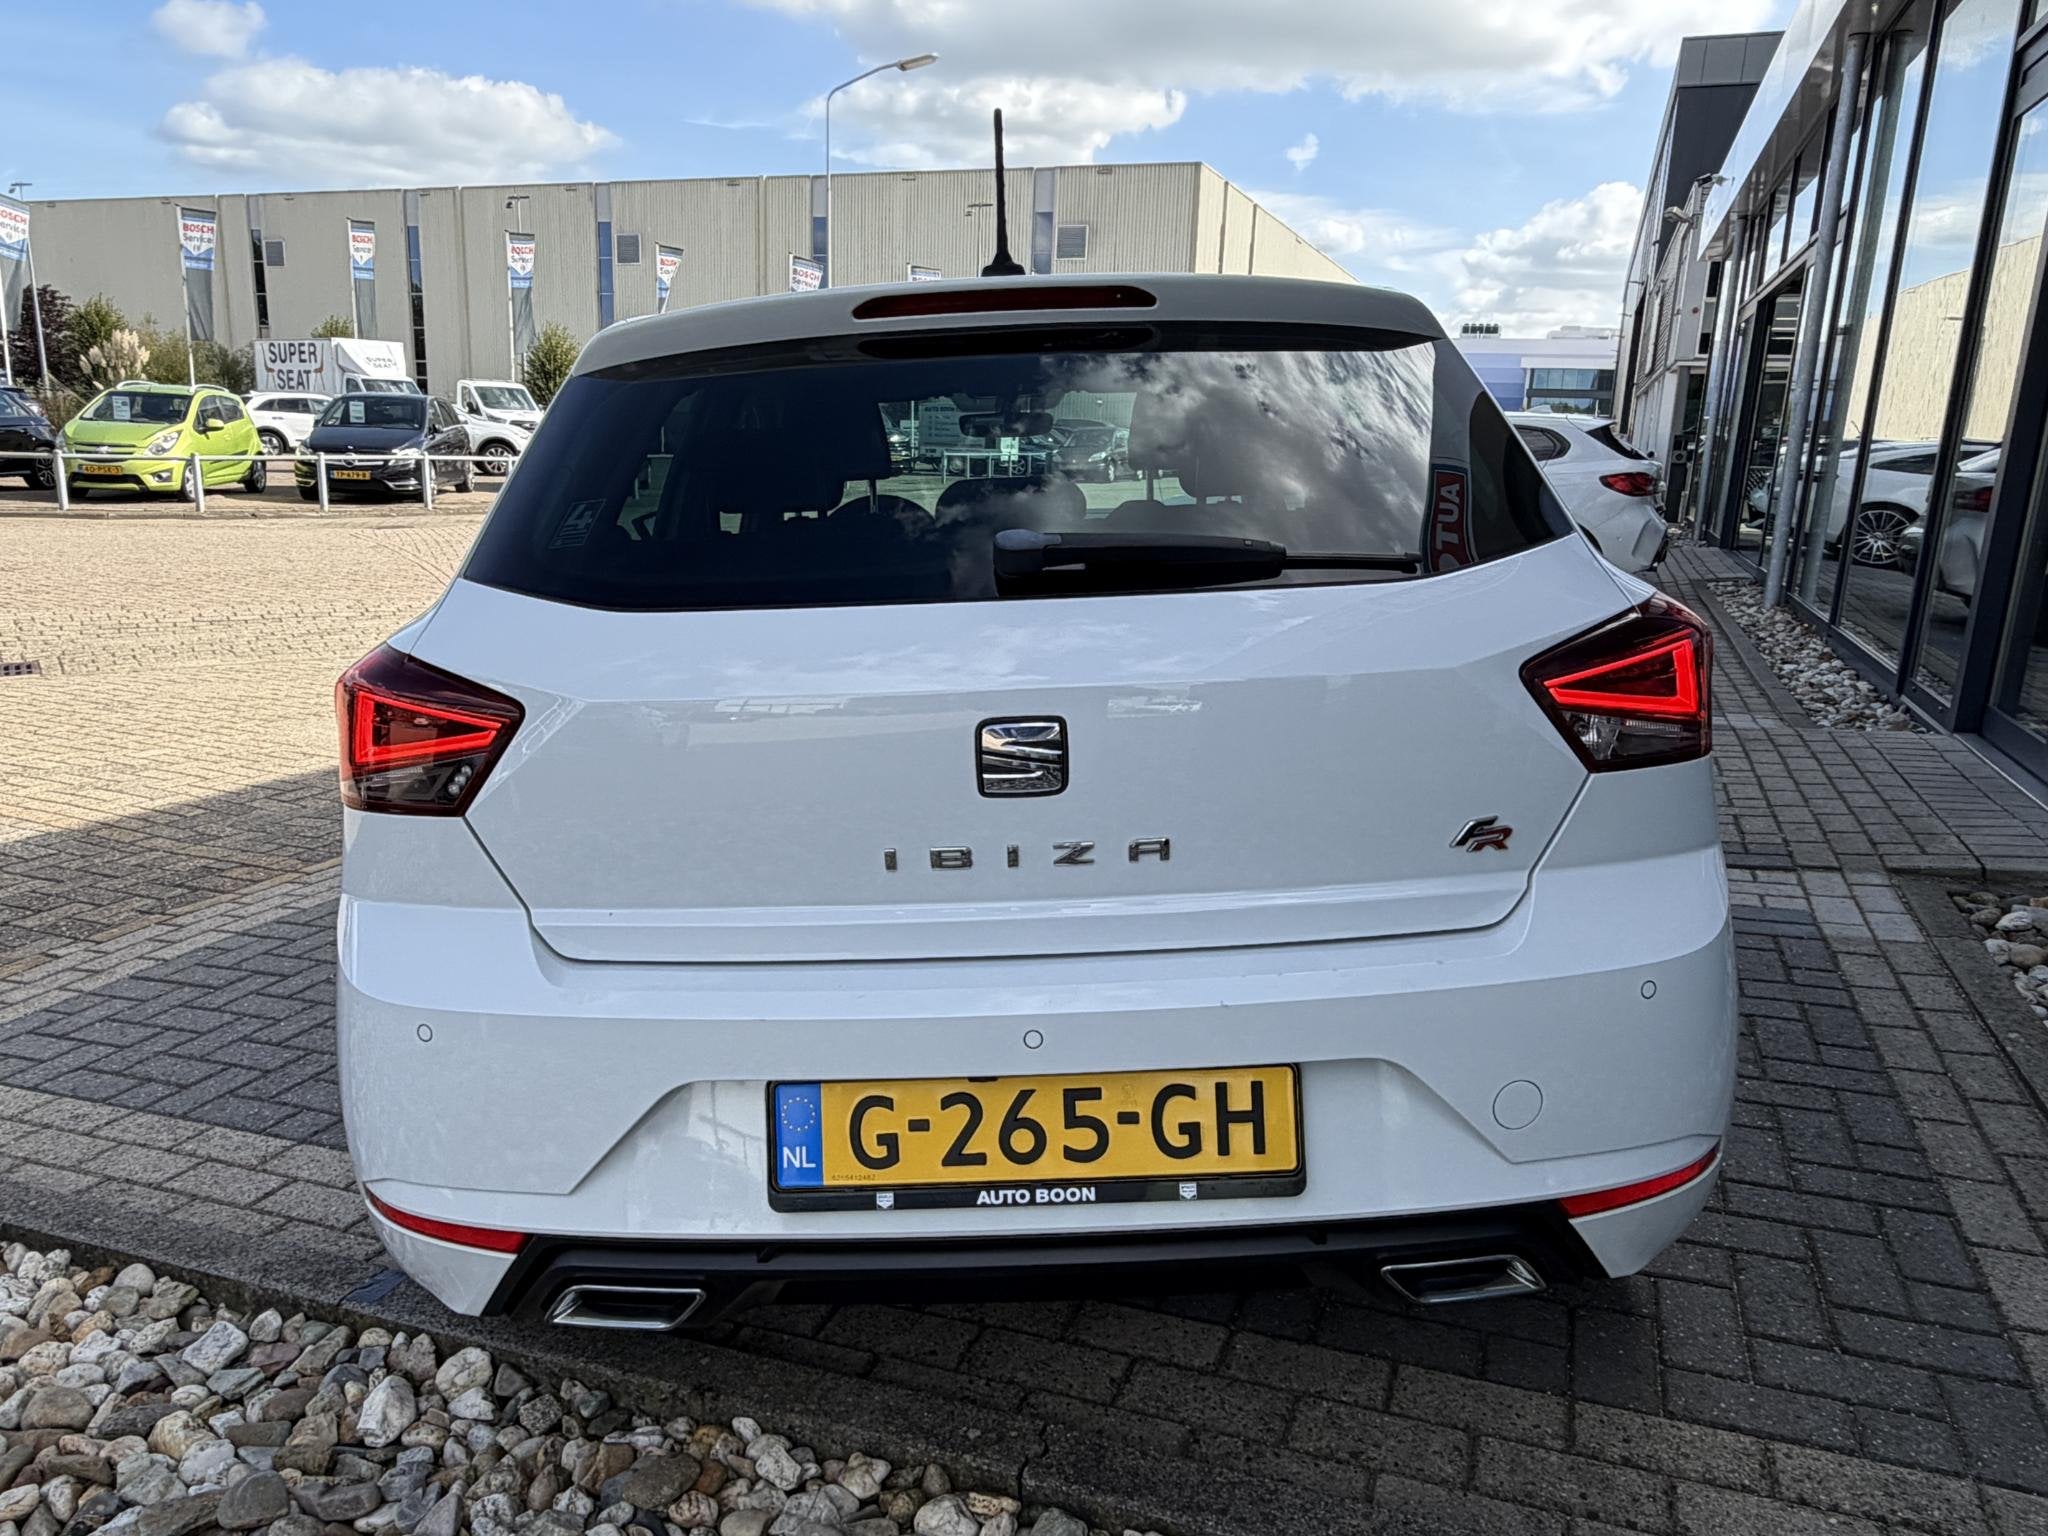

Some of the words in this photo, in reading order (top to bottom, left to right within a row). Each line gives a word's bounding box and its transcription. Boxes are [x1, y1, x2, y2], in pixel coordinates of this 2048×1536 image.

[0, 208, 28, 226] OSCH
[182, 223, 215, 235] BOSCH
[792, 268, 820, 281] BOSCH
[268, 342, 318, 365] SUPER
[276, 369, 312, 391] SEAT
[1449, 814, 1513, 853] FR
[883, 837, 1171, 871] IBIZA
[848, 1080, 1267, 1170] G-265-GH
[782, 1146, 817, 1169] NL
[976, 1189, 1031, 1206] AUTO
[1035, 1186, 1097, 1204] BOON
